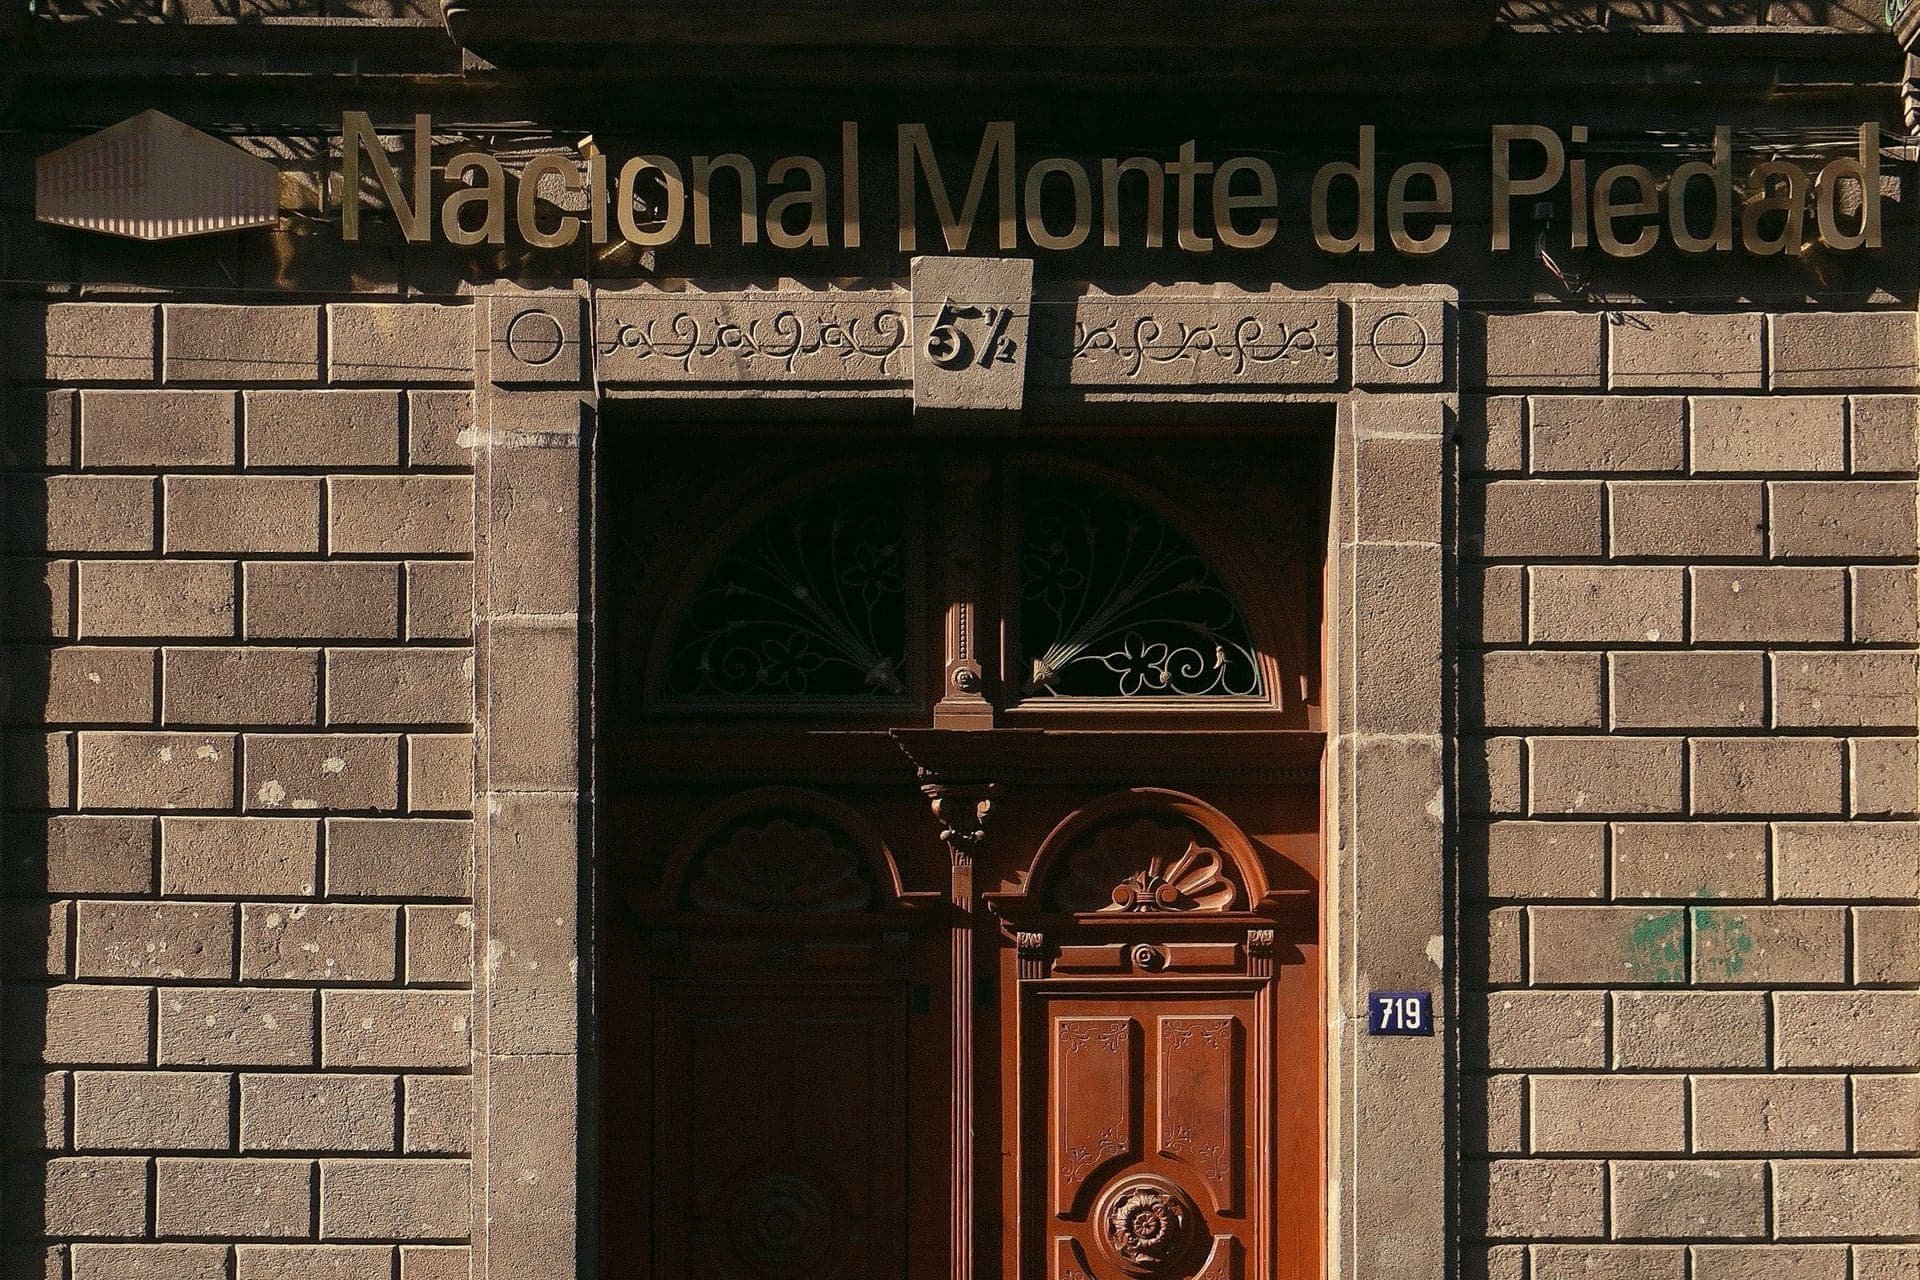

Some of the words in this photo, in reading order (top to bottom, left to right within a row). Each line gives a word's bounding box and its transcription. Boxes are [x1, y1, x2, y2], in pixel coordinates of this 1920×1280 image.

[342, 111, 860, 249] Nacional
[898, 121, 1278, 253] Monte
[1311, 125, 1453, 255] de
[1492, 122, 1882, 257] Piedad
[1379, 998, 1420, 1029] 719
